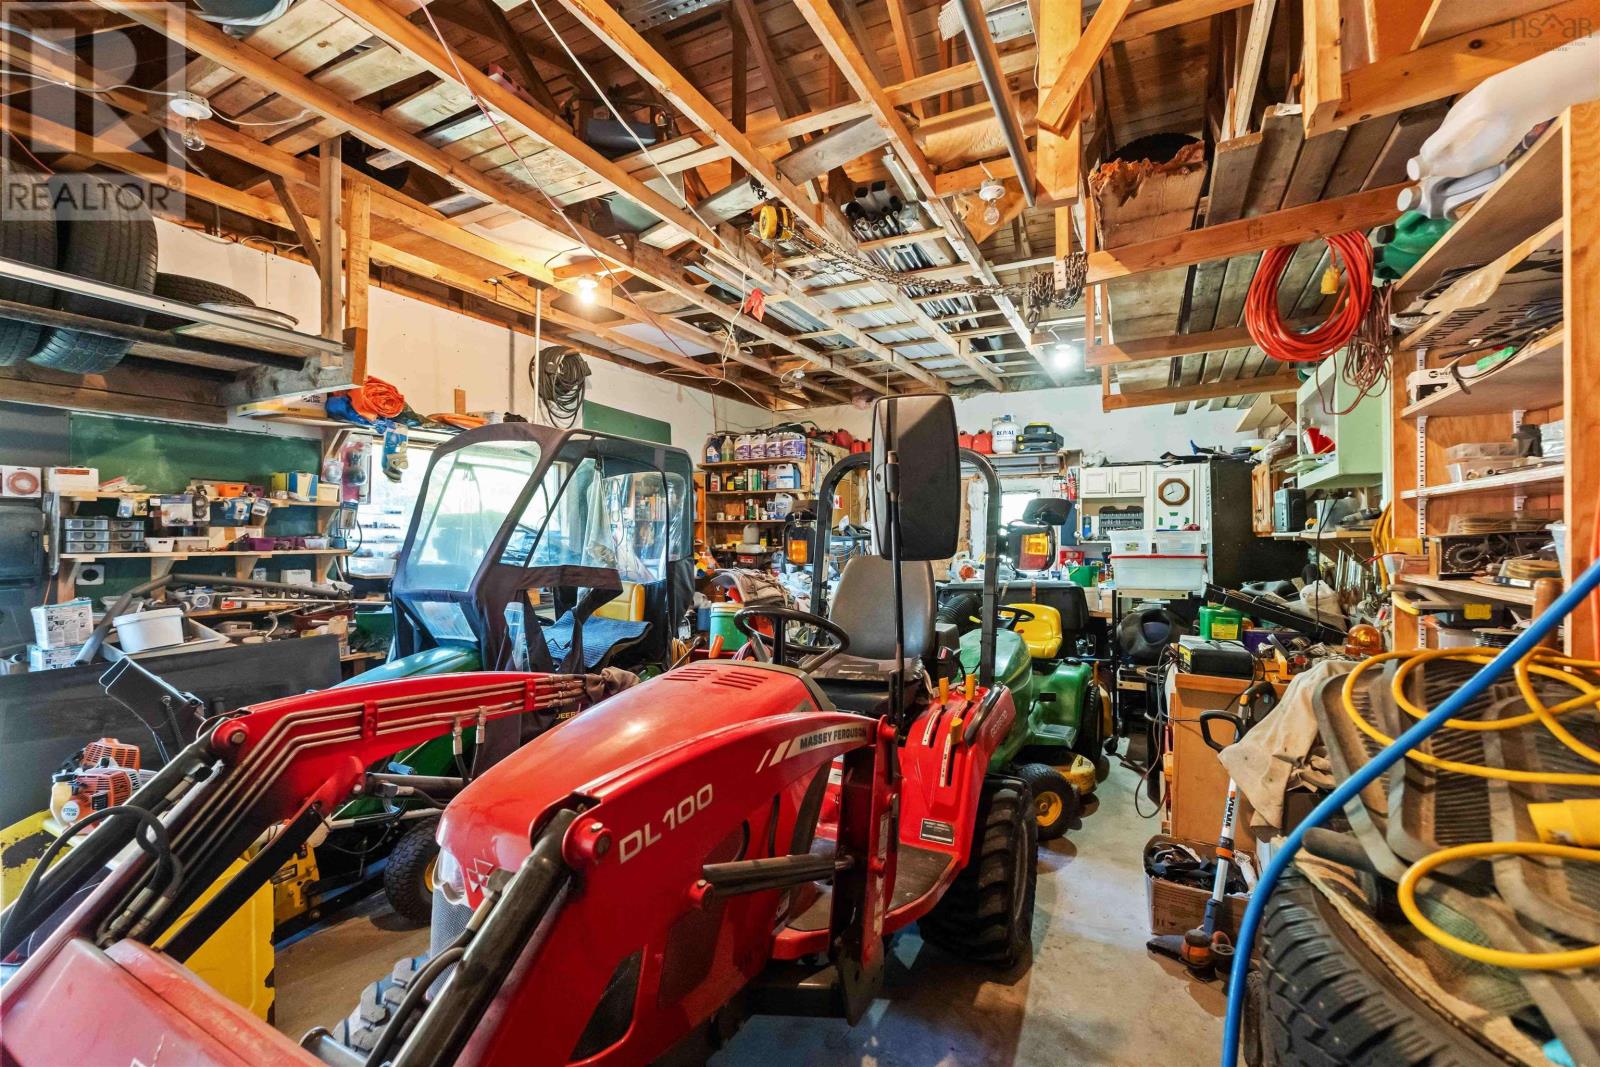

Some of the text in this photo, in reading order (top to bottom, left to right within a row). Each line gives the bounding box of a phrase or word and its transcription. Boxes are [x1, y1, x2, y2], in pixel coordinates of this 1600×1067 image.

[800, 726, 867, 749] MASSEY FERGUSON
[618, 783, 713, 865] DL 100
